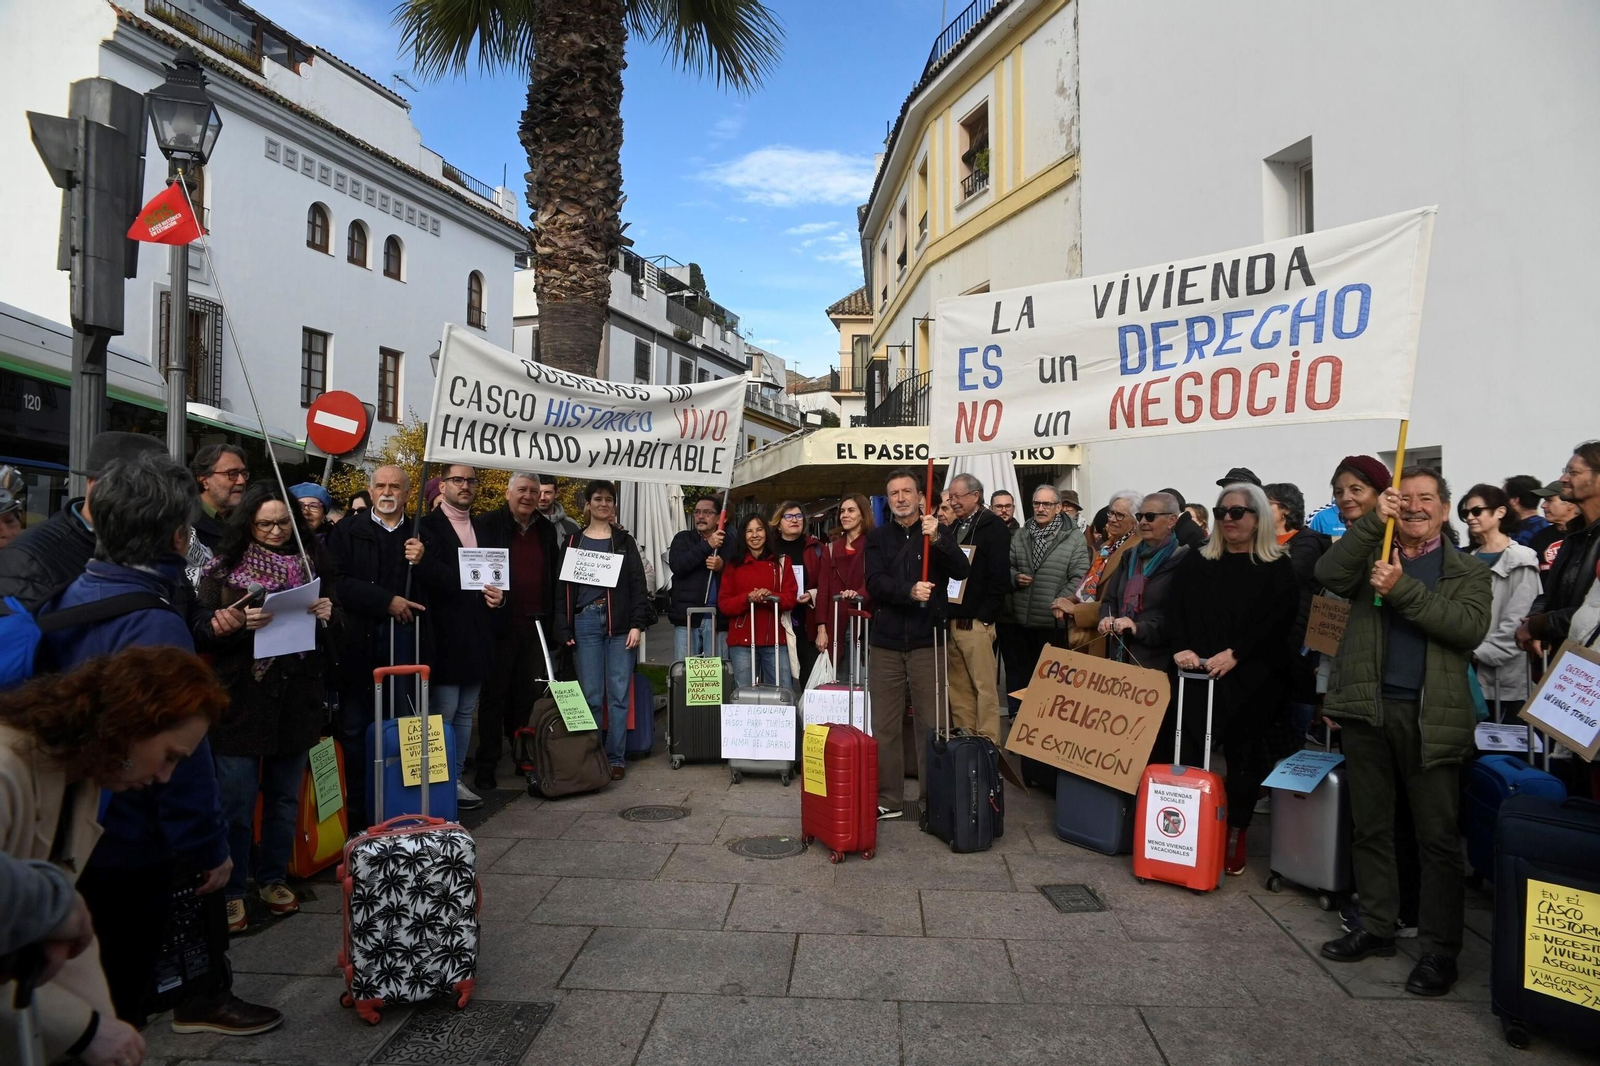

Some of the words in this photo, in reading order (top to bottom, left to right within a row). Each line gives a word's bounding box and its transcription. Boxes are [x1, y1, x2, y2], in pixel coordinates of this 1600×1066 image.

[144, 204, 174, 226] SOS
[991, 296, 1036, 335] LA
[958, 344, 1003, 391] ES
[1039, 353, 1078, 384] un
[1118, 283, 1372, 376] DERECHO
[520, 358, 650, 401] QUEREMOS
[664, 385, 693, 403] UN
[23, 394, 41, 411] 120
[450, 376, 536, 422] CASCO
[955, 398, 1003, 443] NO
[1033, 408, 1070, 437] un
[837, 443, 857, 460] EL
[864, 443, 929, 460] PASEO
[1038, 659, 1088, 688] CASCO
[1087, 676, 1159, 707] HISTÓRICO
[806, 693, 815, 704] NO
[818, 694, 827, 704] AL
[822, 705, 848, 714] MASIV
[726, 719, 743, 727] PISOS
[747, 719, 763, 728] PARA
[806, 714, 863, 724] RECUPEREOS
[755, 729, 778, 737] VENDE
[731, 738, 749, 747] ALMA
[753, 739, 763, 748] DEL
[1016, 723, 1039, 746] DE
[1041, 734, 1133, 775] EXTINCIÓN
[313, 750, 329, 763] CASCO
[1160, 796, 1186, 804] SOCIALES
[1166, 791, 1193, 800] VIVIENDAS
[1147, 839, 1166, 847] MENOS
[1166, 842, 1194, 852] VIVIENDAS
[1151, 846, 1190, 857] VACACIONALES
[1541, 889, 1559, 901] EN
[1538, 900, 1583, 920] CASCO
[1536, 914, 1600, 937] HISTORI
[1532, 978, 1576, 996] ACTUA
